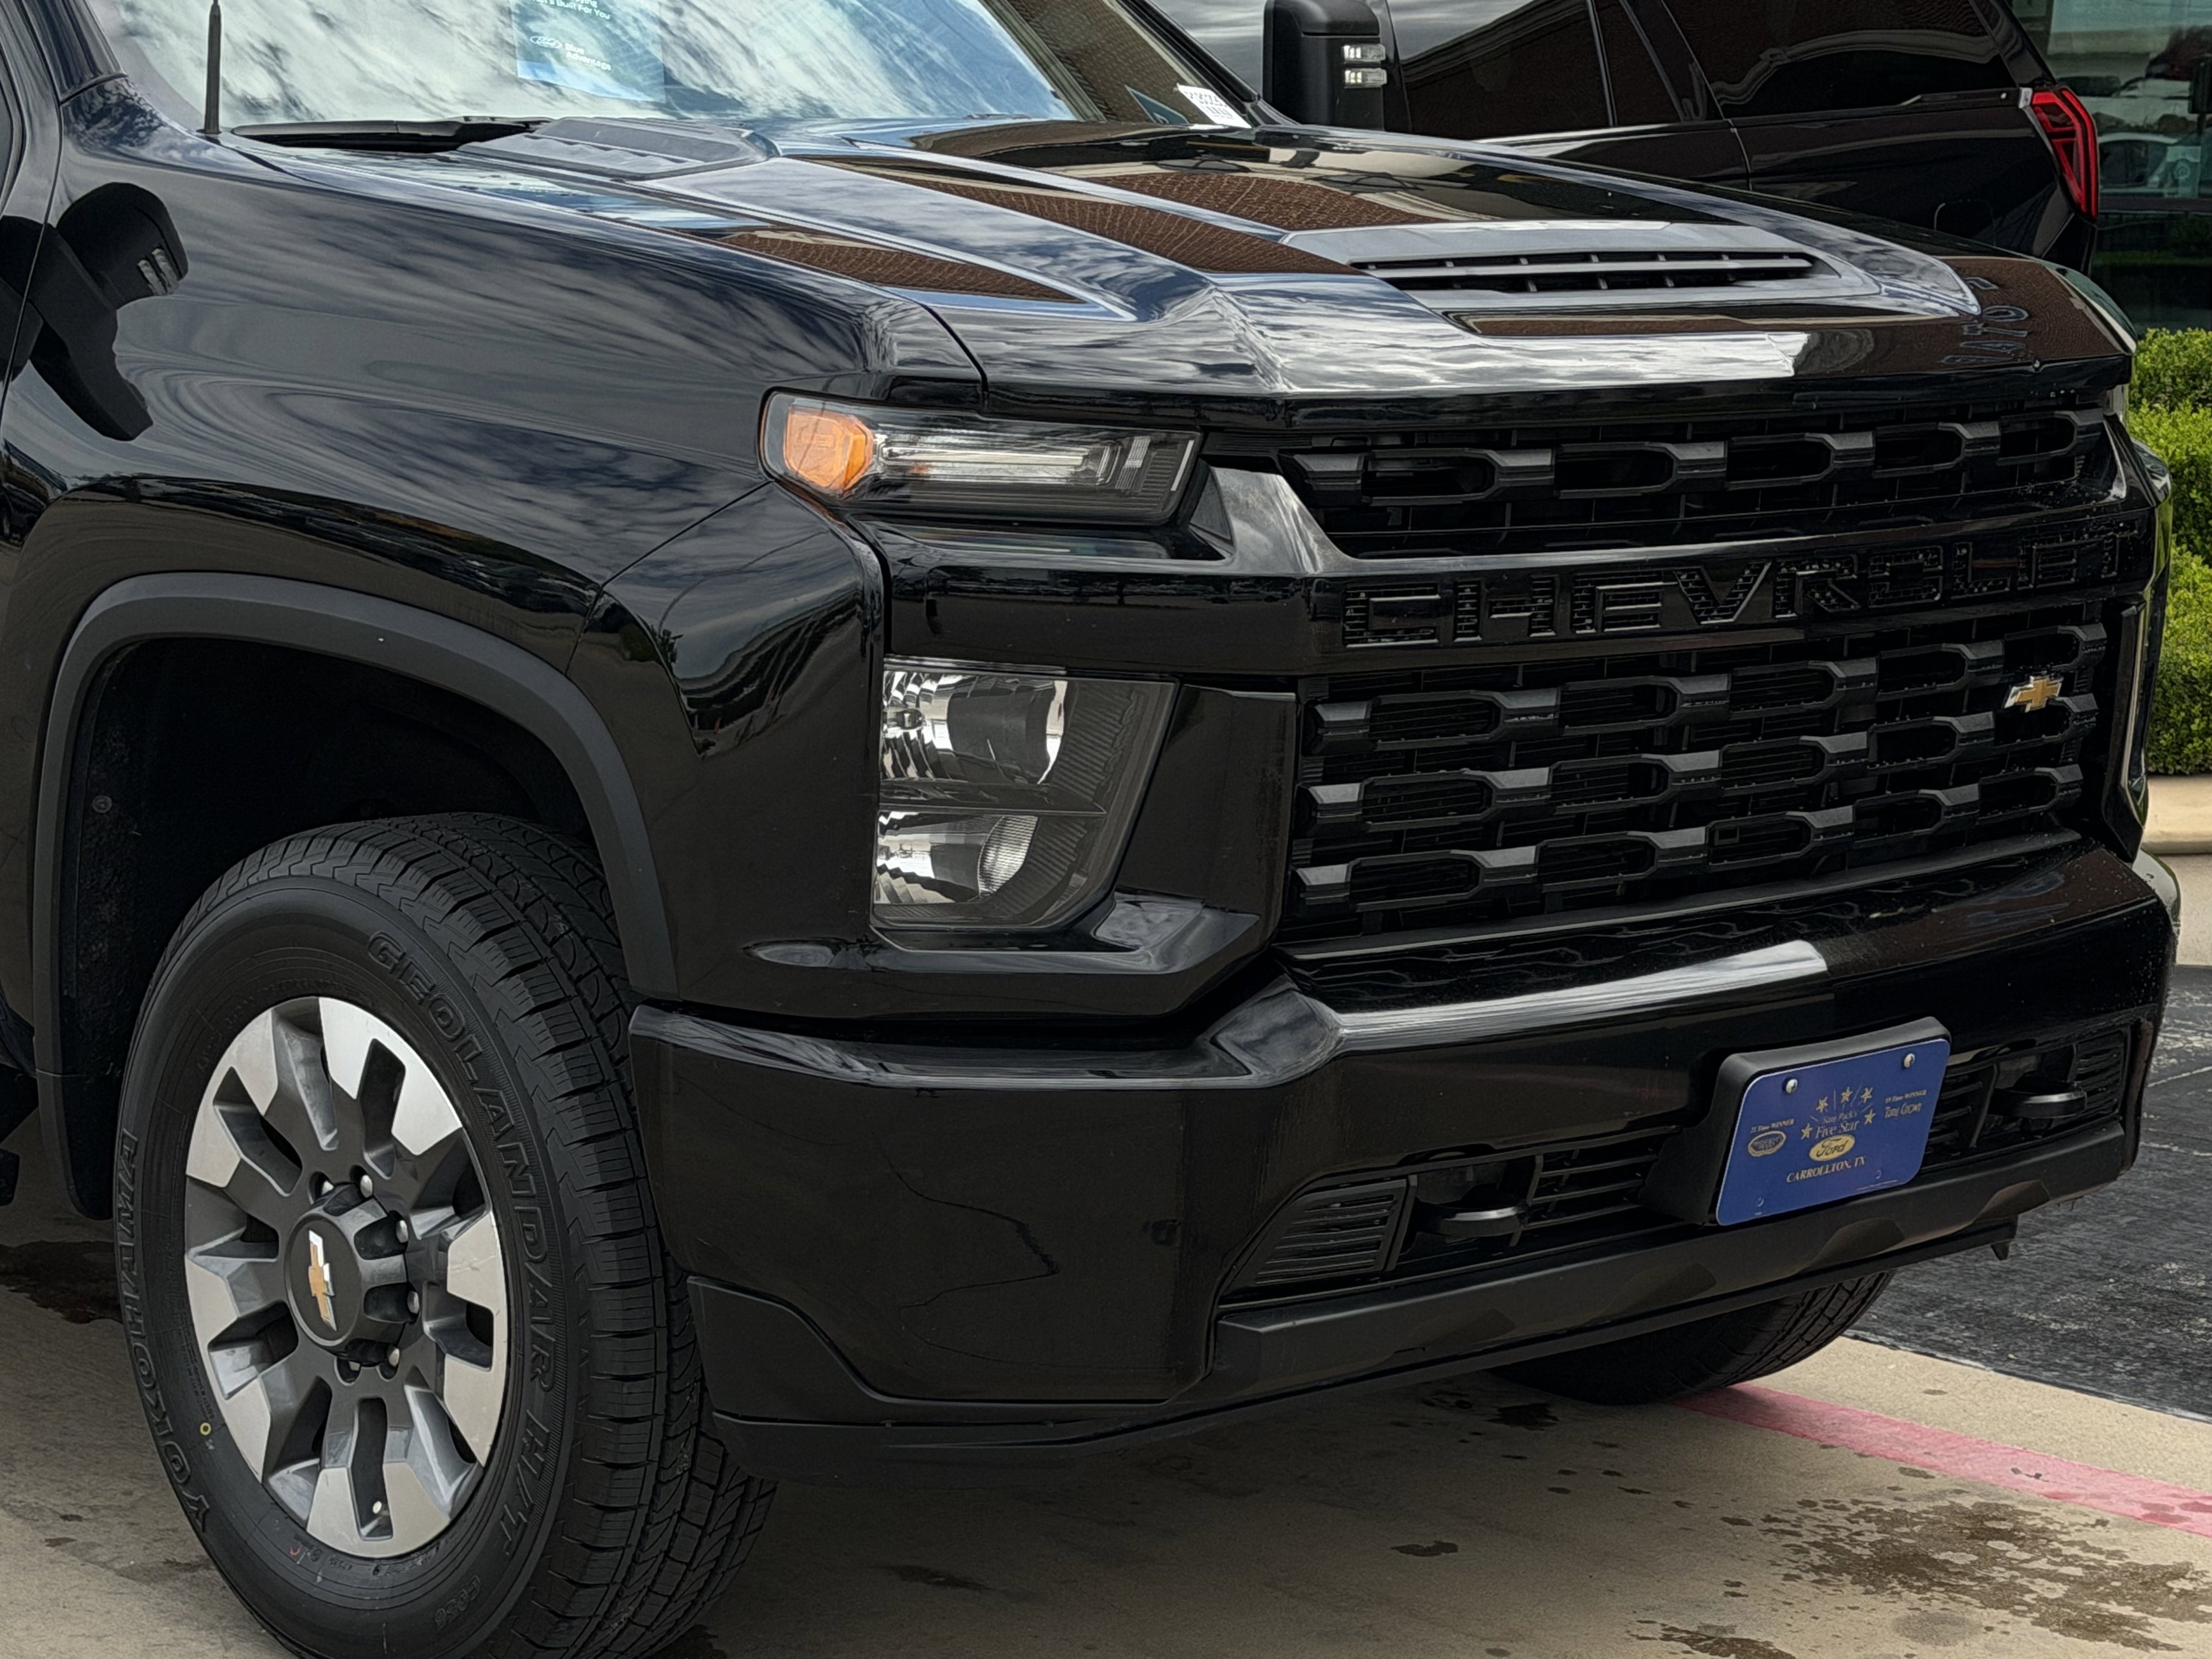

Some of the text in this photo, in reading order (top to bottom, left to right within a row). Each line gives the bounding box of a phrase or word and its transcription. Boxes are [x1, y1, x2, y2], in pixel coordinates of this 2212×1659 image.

[578, 4, 592, 14] For
[594, 8, 611, 20] You
[565, 43, 585, 54] Blue
[566, 51, 612, 71] Advantage
[1342, 516, 2143, 648] CHEVROLET
[1815, 1120, 1860, 1138] Five Star
[1816, 1137, 1849, 1158] Ford
[367, 930, 555, 1392] GEOLANDAR
[1854, 1156, 1865, 1167] TX
[118, 1127, 210, 1533] YOKOHAMA
